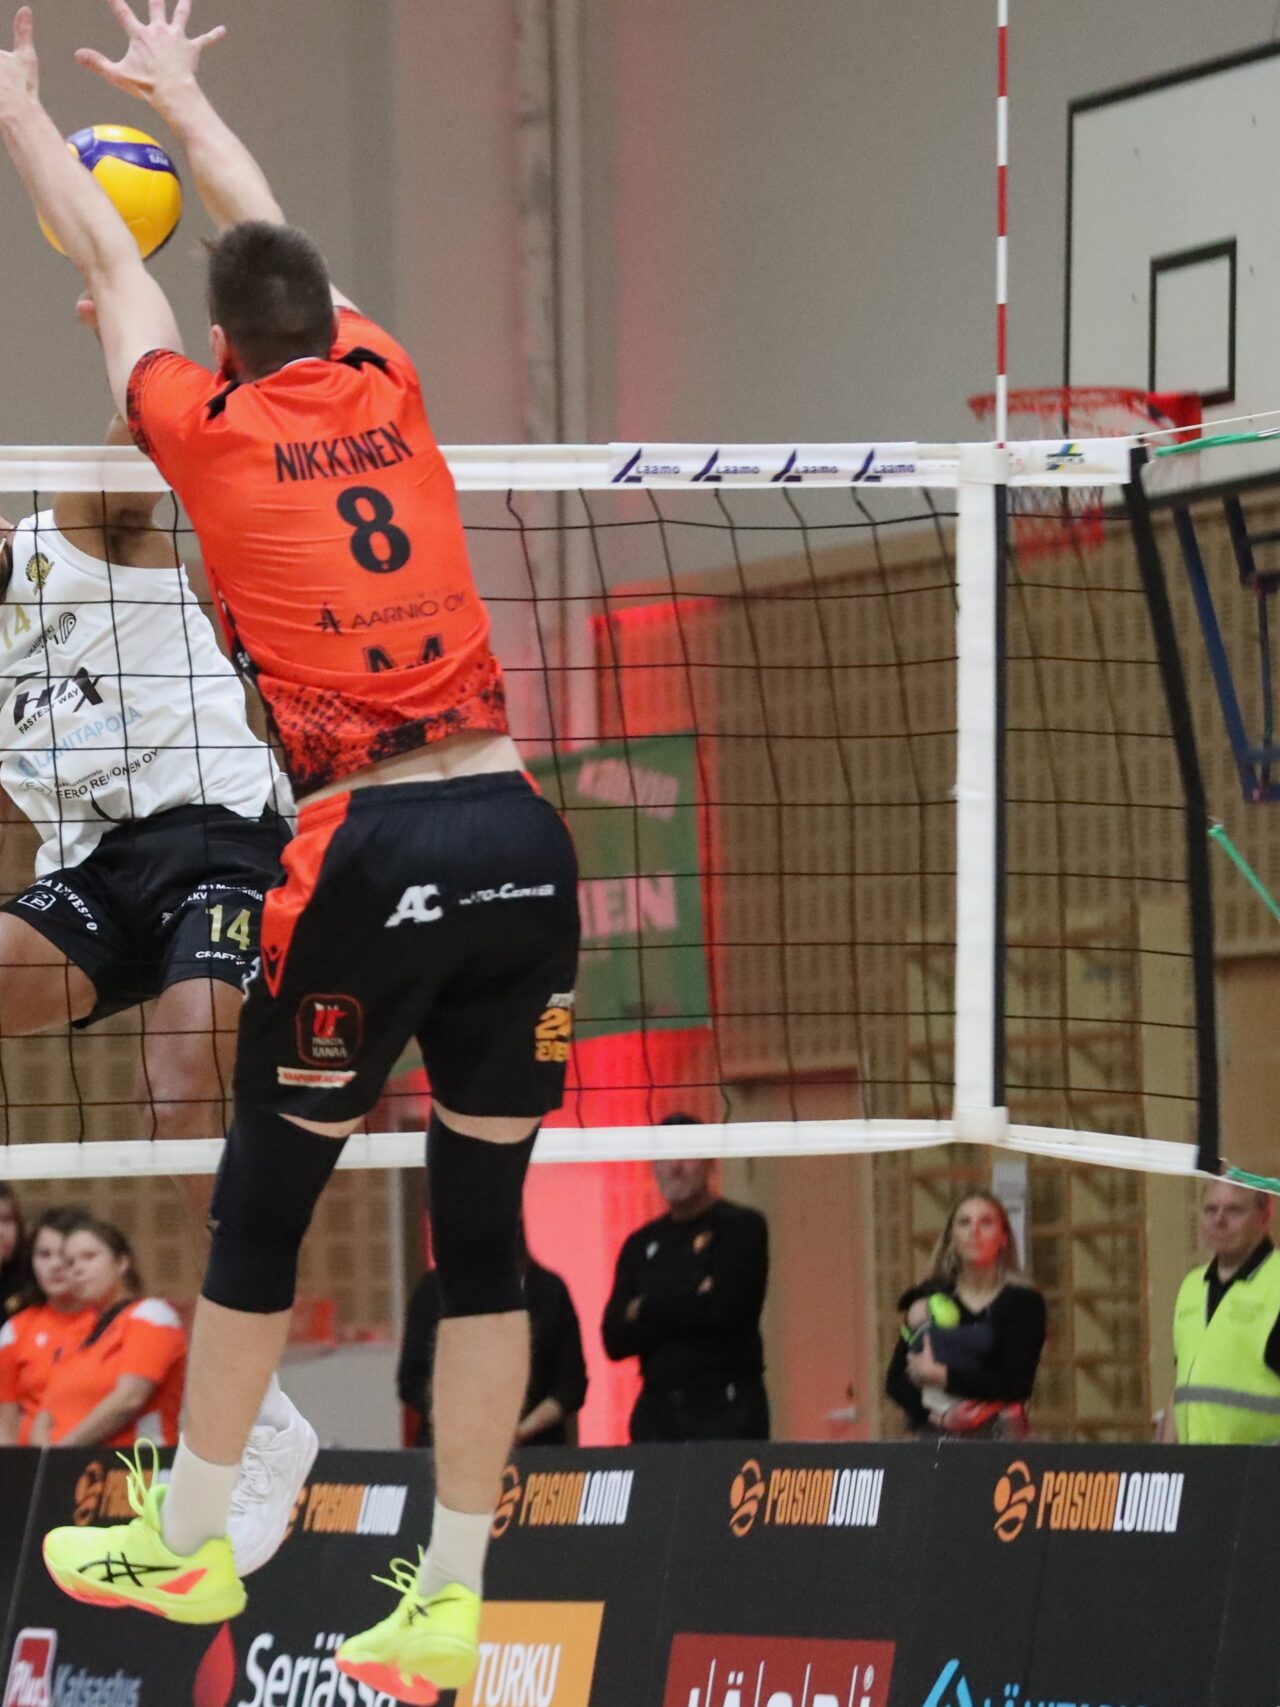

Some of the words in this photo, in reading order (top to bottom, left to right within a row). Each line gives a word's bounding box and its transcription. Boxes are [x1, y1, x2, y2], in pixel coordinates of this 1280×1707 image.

[274, 421, 414, 482] NIKKINEN
[636, 464, 680, 475] Laamo
[716, 464, 760, 475] Laamo
[794, 464, 838, 475] Laamo
[873, 462, 915, 475] Laamo
[336, 485, 412, 574] 8
[351, 600, 440, 630] AARNIO
[384, 883, 444, 928] AC
[205, 904, 252, 951] 14
[473, 1642, 562, 1707] TURKU
